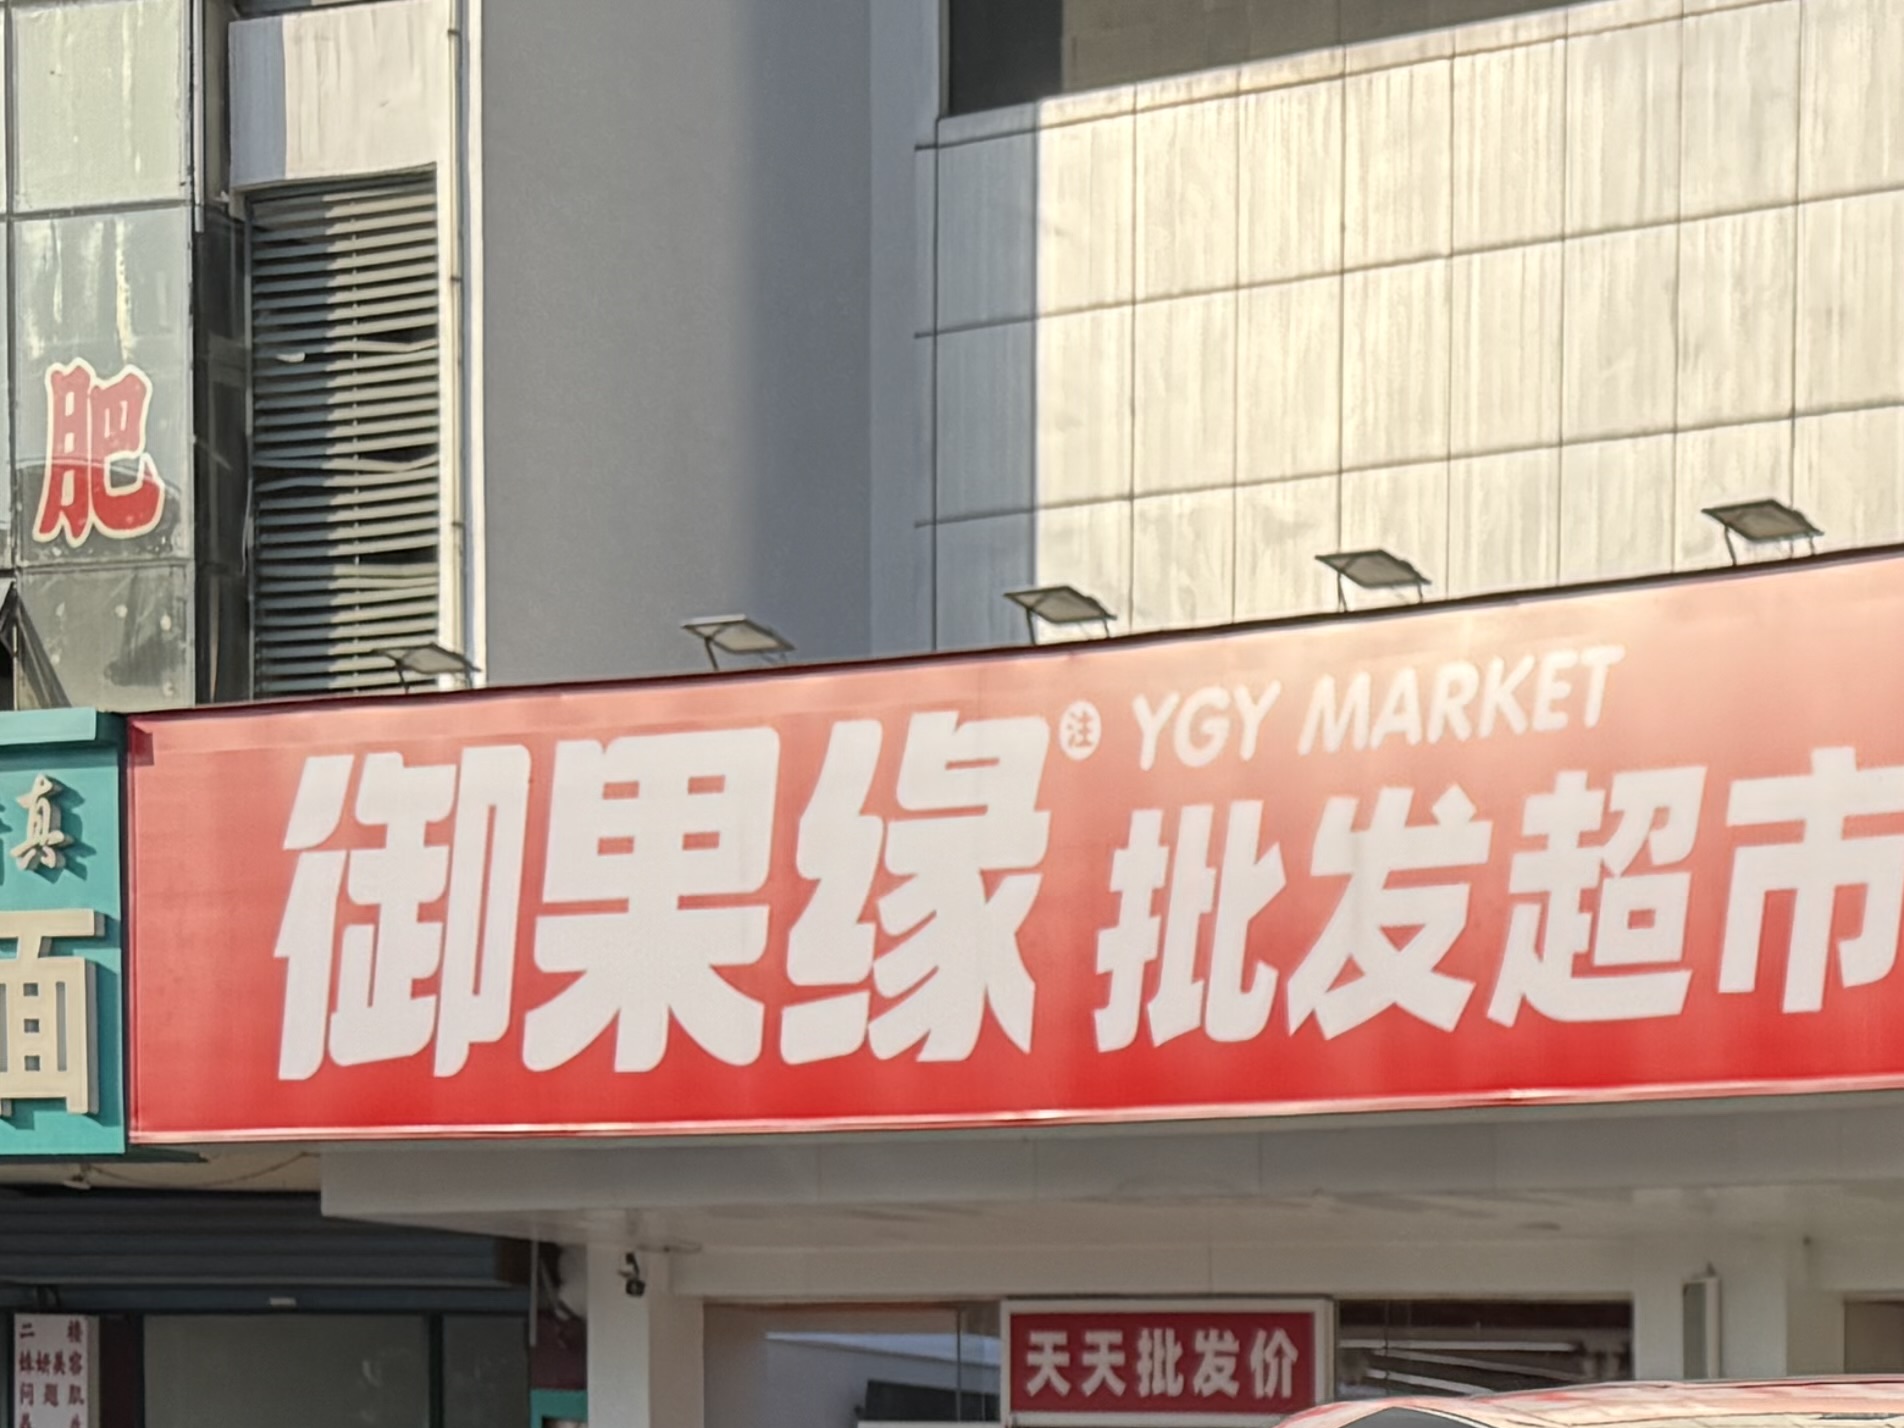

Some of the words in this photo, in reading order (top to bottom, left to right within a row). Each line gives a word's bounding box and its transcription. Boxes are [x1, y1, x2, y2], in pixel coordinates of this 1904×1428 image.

[32, 357, 166, 549] 肥
[1132, 680, 1282, 772] YGY
[1297, 644, 1626, 757] MARKET
[273, 709, 1051, 1082] 御果缘
[0, 908, 95, 1114] 面
[1026, 1327, 1299, 1399] 天天批发价
